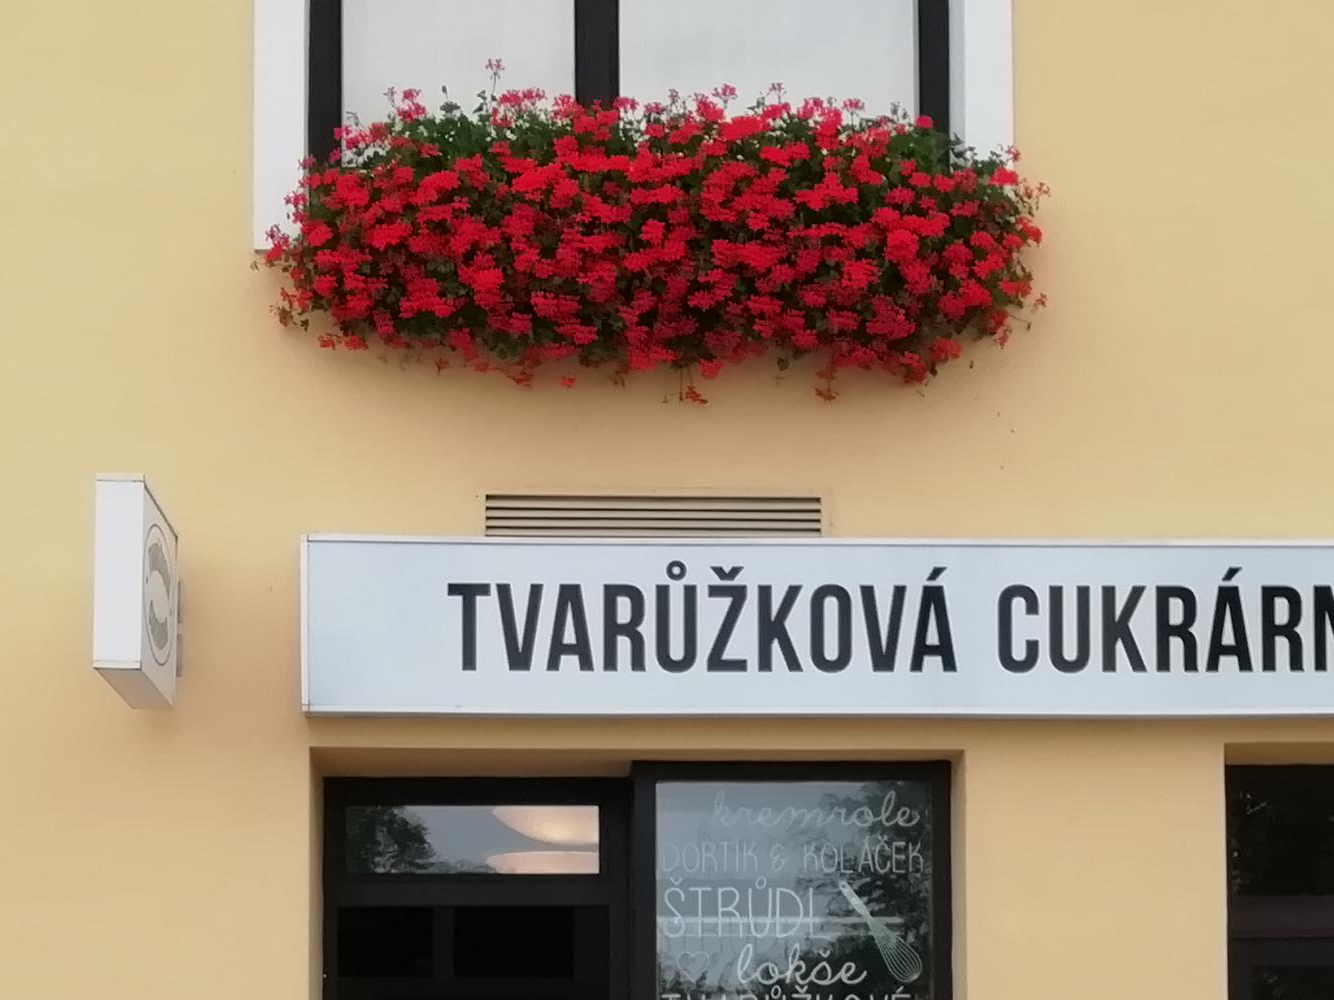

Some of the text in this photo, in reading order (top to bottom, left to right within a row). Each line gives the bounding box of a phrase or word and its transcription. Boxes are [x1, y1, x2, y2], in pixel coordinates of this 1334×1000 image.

[446, 560, 958, 673] TVARŮŽKOVÁ
[714, 789, 921, 829] kremrole
[803, 834, 924, 874] KOLÁČEK
[664, 876, 834, 939] ŠTRŮDL
[737, 943, 867, 985] lokše
